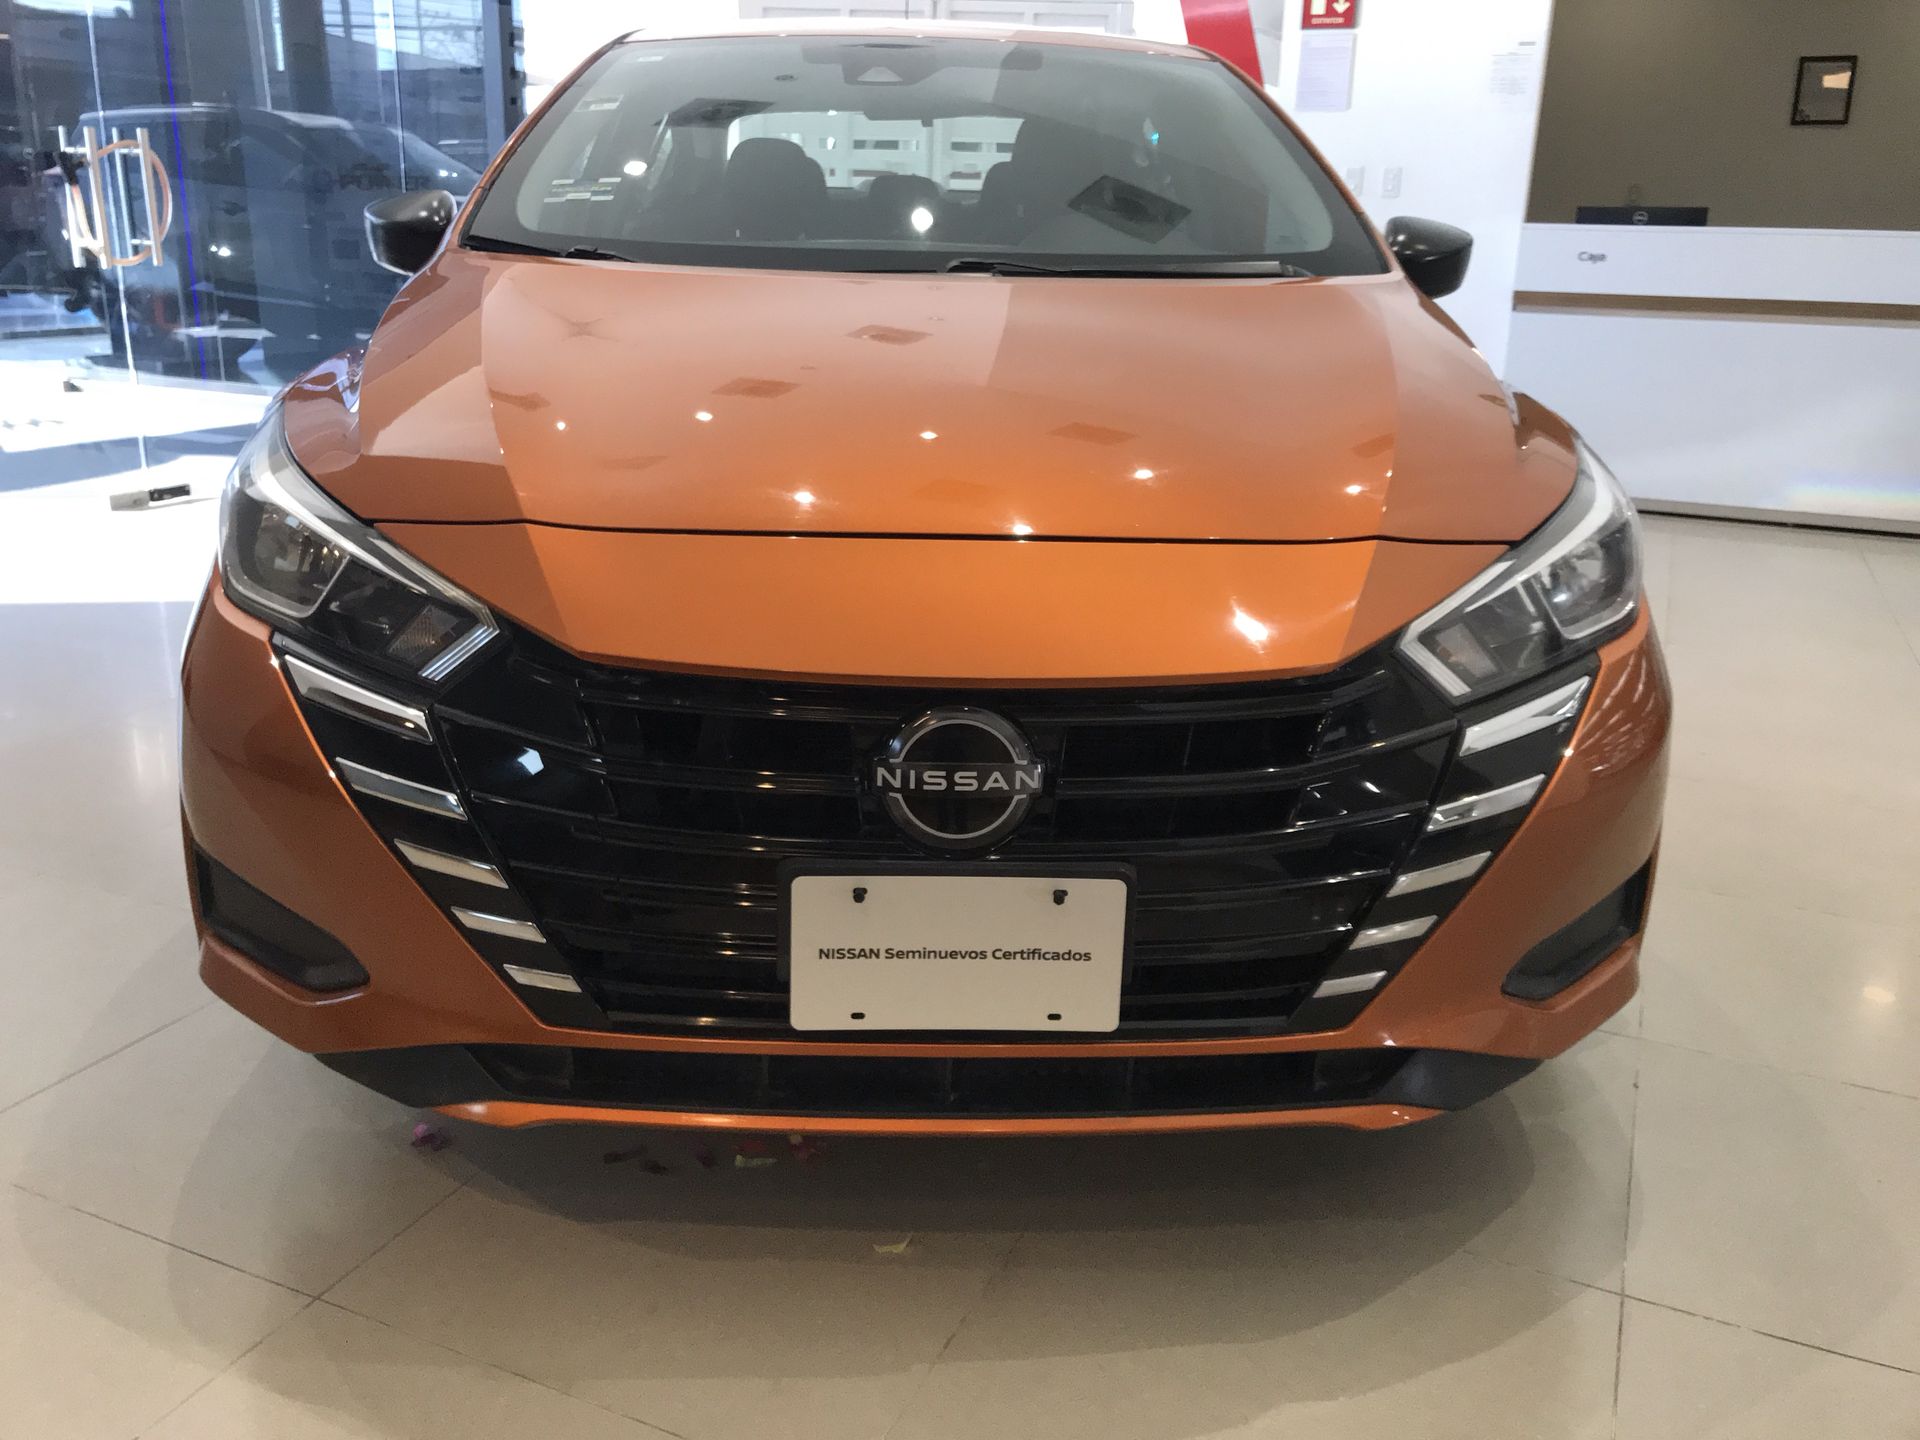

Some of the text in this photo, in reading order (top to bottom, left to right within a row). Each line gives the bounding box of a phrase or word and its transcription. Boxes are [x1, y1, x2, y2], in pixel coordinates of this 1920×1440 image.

[876, 767, 1040, 791] NISSAN
[818, 947, 1092, 962] NISSAN Seminuevos Certificados
